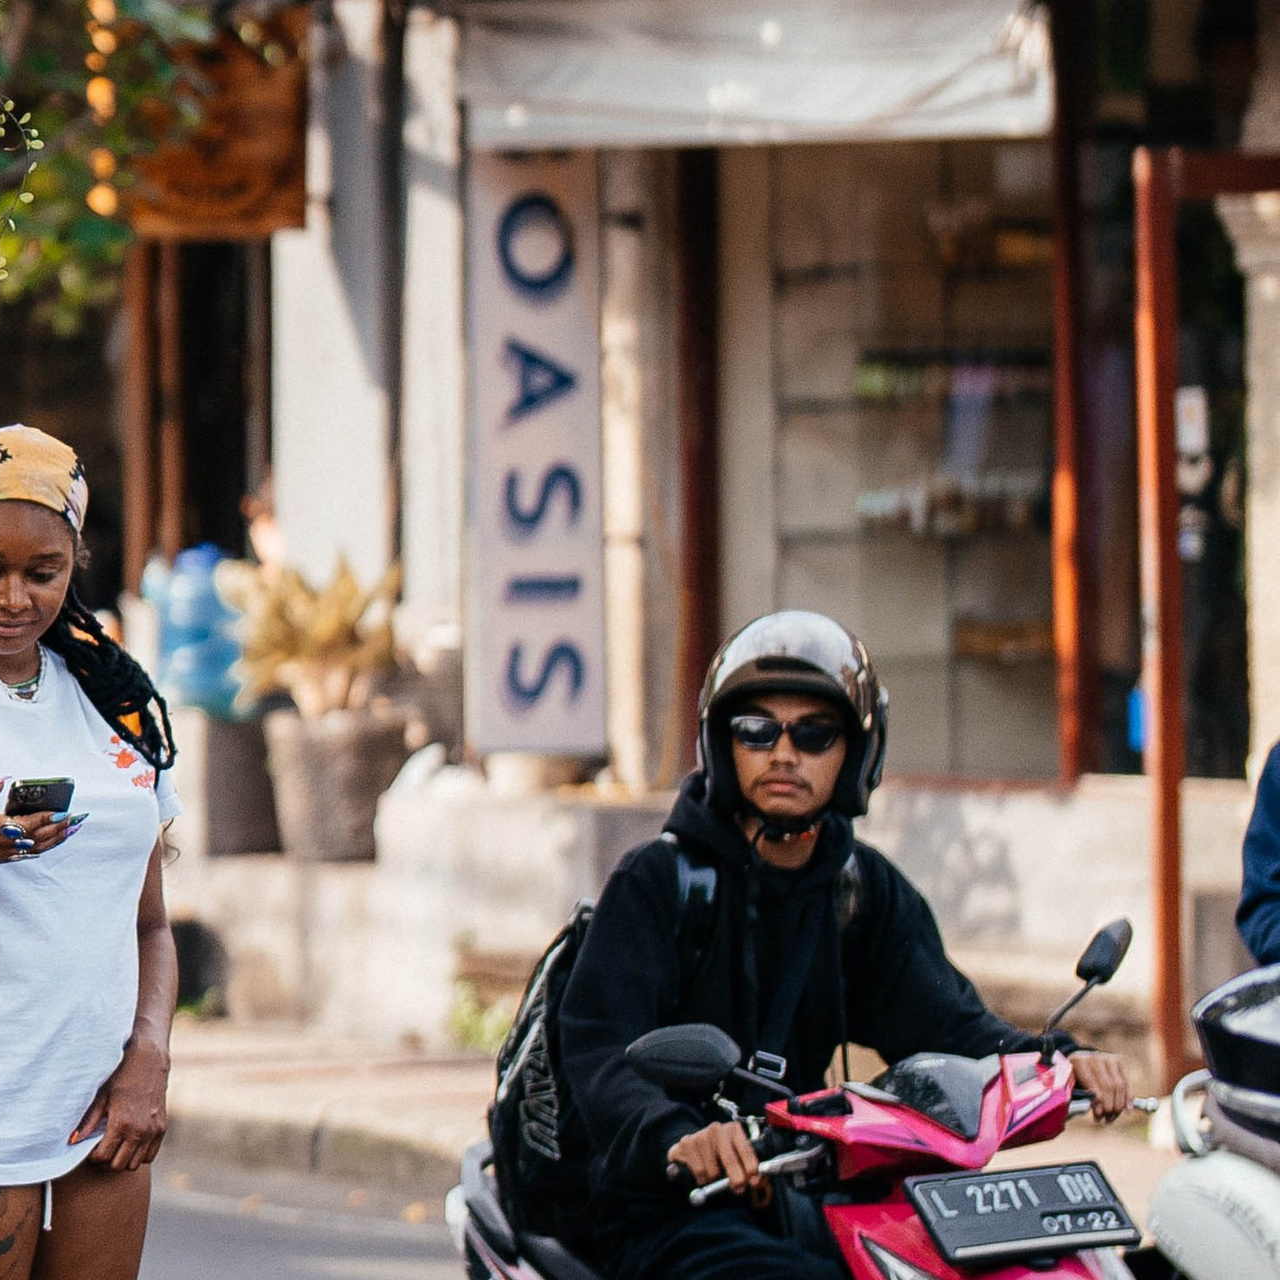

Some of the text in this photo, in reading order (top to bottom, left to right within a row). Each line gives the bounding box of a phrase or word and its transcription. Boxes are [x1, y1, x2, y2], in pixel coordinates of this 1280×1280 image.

[496, 193, 585, 717] OASIS
[930, 1190, 958, 1219] L
[966, 1178, 1041, 1215] 2271
